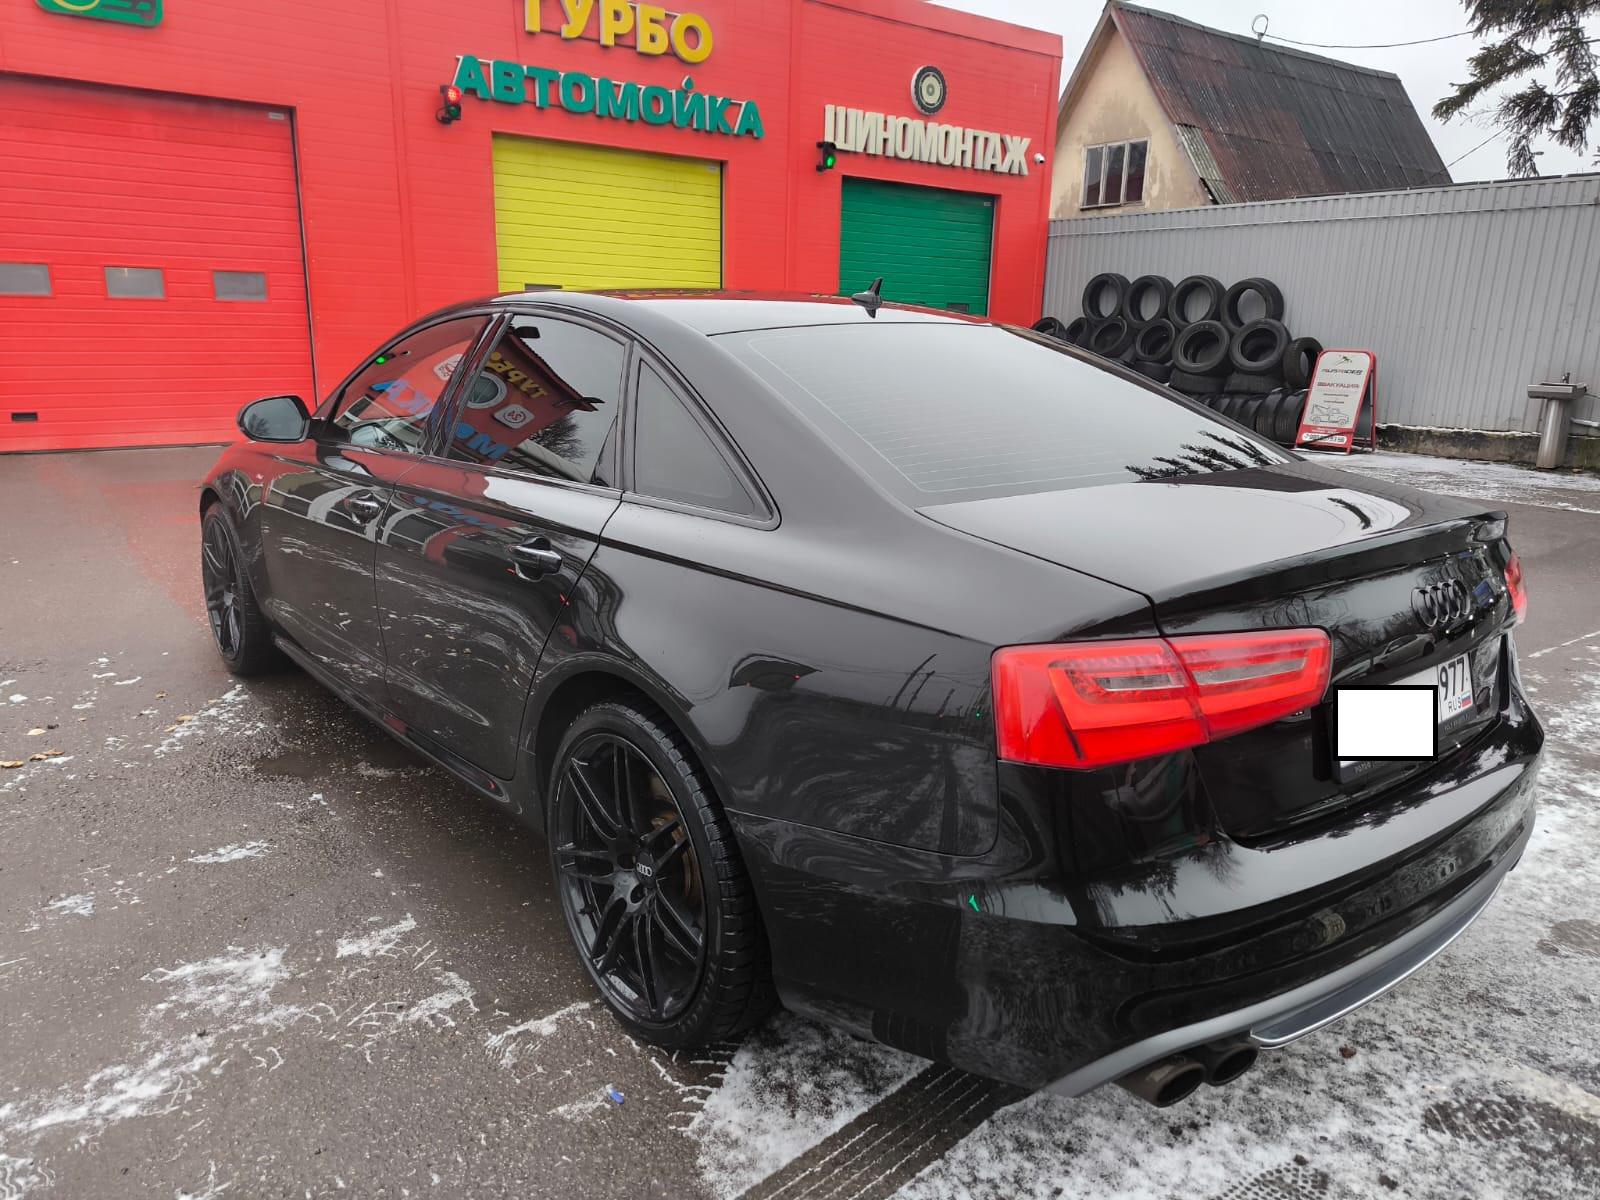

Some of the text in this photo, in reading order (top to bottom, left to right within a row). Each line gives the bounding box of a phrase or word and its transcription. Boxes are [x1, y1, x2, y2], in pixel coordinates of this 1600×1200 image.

[524, 0, 713, 63] ТУРБО
[453, 55, 764, 138] АВТОМОЙКА
[824, 104, 1031, 175] ШИНОМОНТАЖ
[1439, 656, 1465, 702] 977
[1448, 697, 1462, 713] RUS
